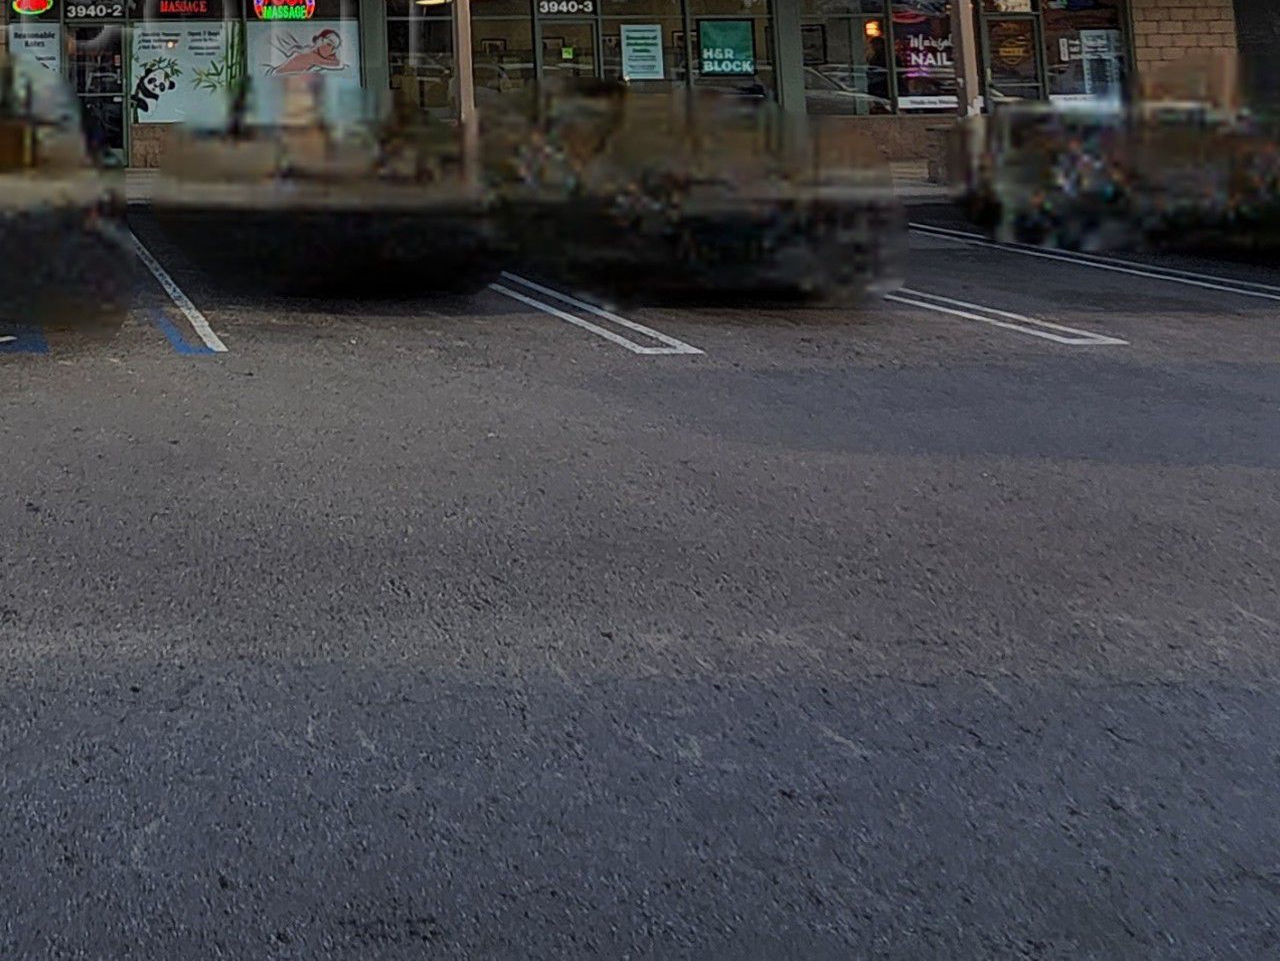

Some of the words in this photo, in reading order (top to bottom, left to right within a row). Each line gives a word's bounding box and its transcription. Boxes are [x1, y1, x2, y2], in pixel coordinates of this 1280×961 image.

[66, 4, 123, 18] 3940-2
[159, 0, 209, 13] MASSAGE
[262, 5, 307, 19] MASSAGE
[539, 0, 594, 13] 3940-3
[703, 49, 734, 60] H&R
[703, 60, 753, 72] BLOCK
